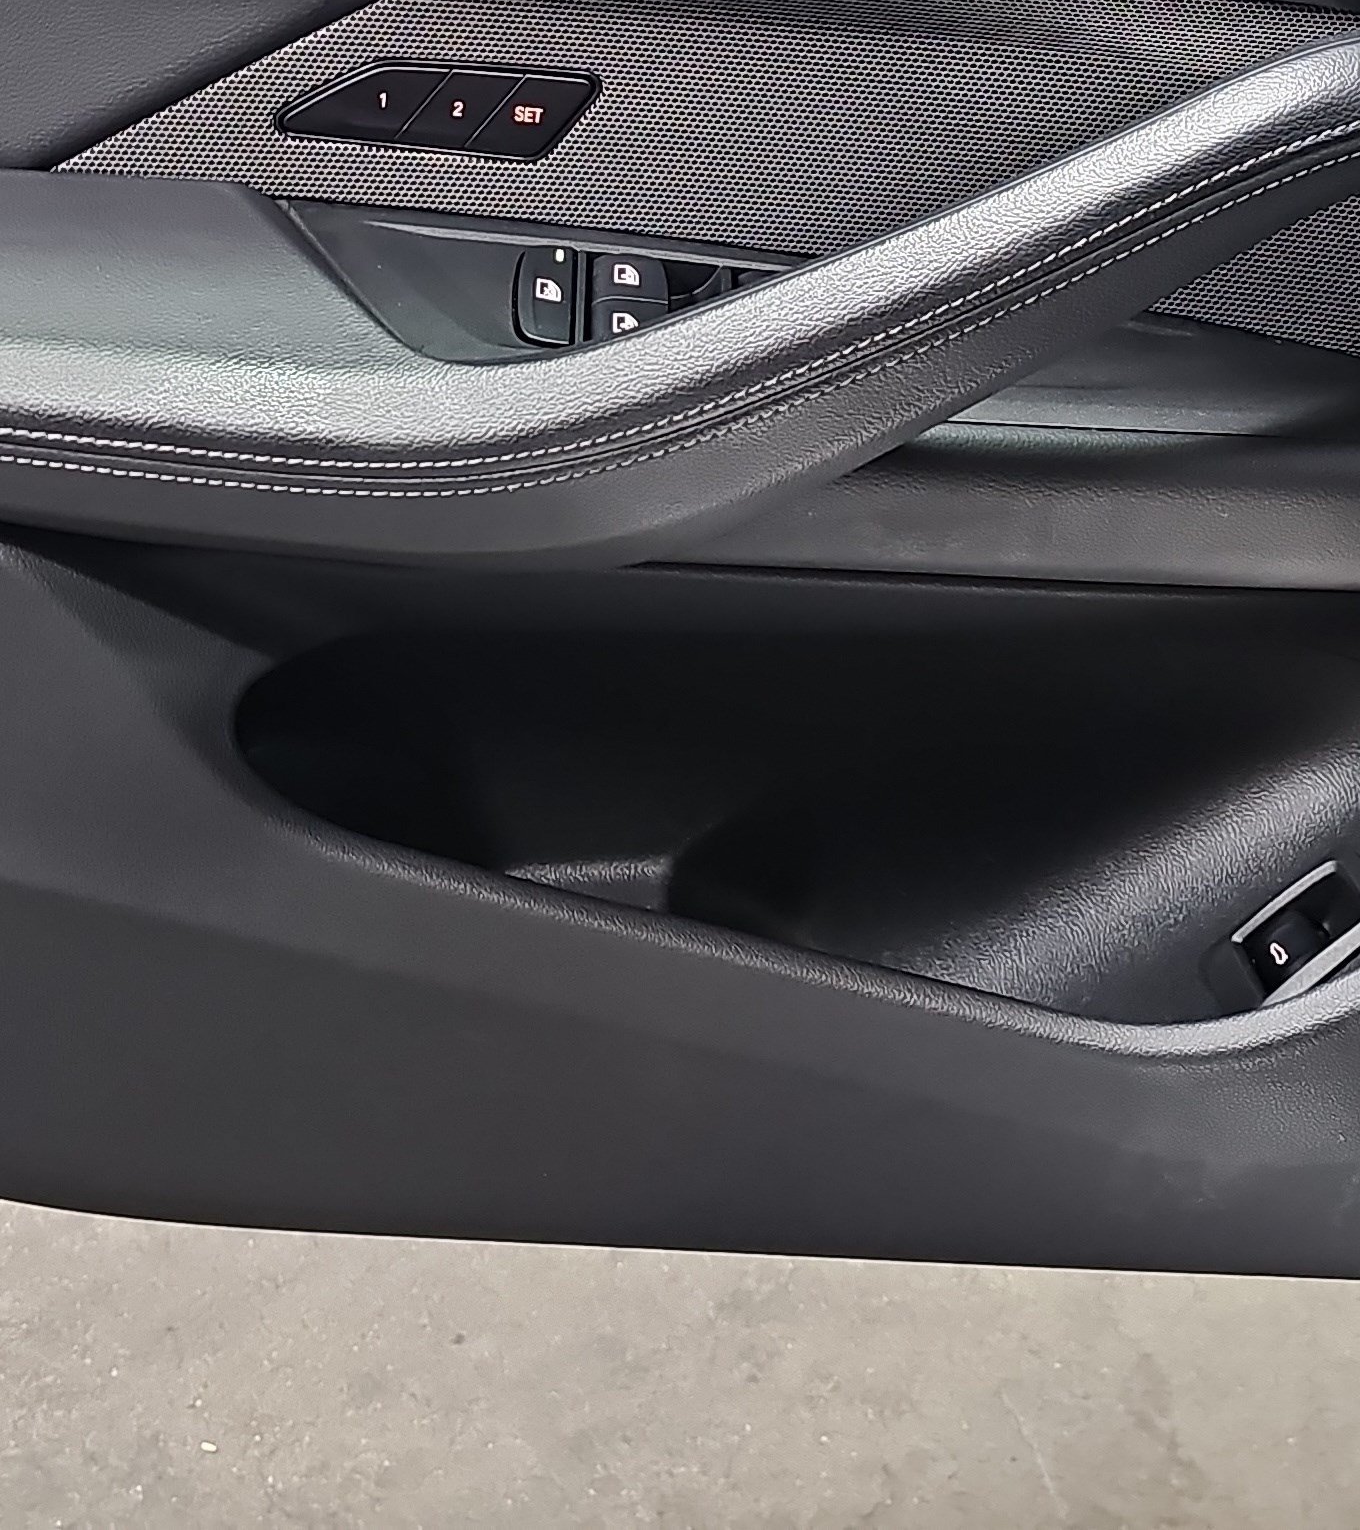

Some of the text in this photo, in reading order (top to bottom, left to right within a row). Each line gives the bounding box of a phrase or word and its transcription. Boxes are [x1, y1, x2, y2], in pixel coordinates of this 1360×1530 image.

[379, 92, 544, 124] 1 2 SET
